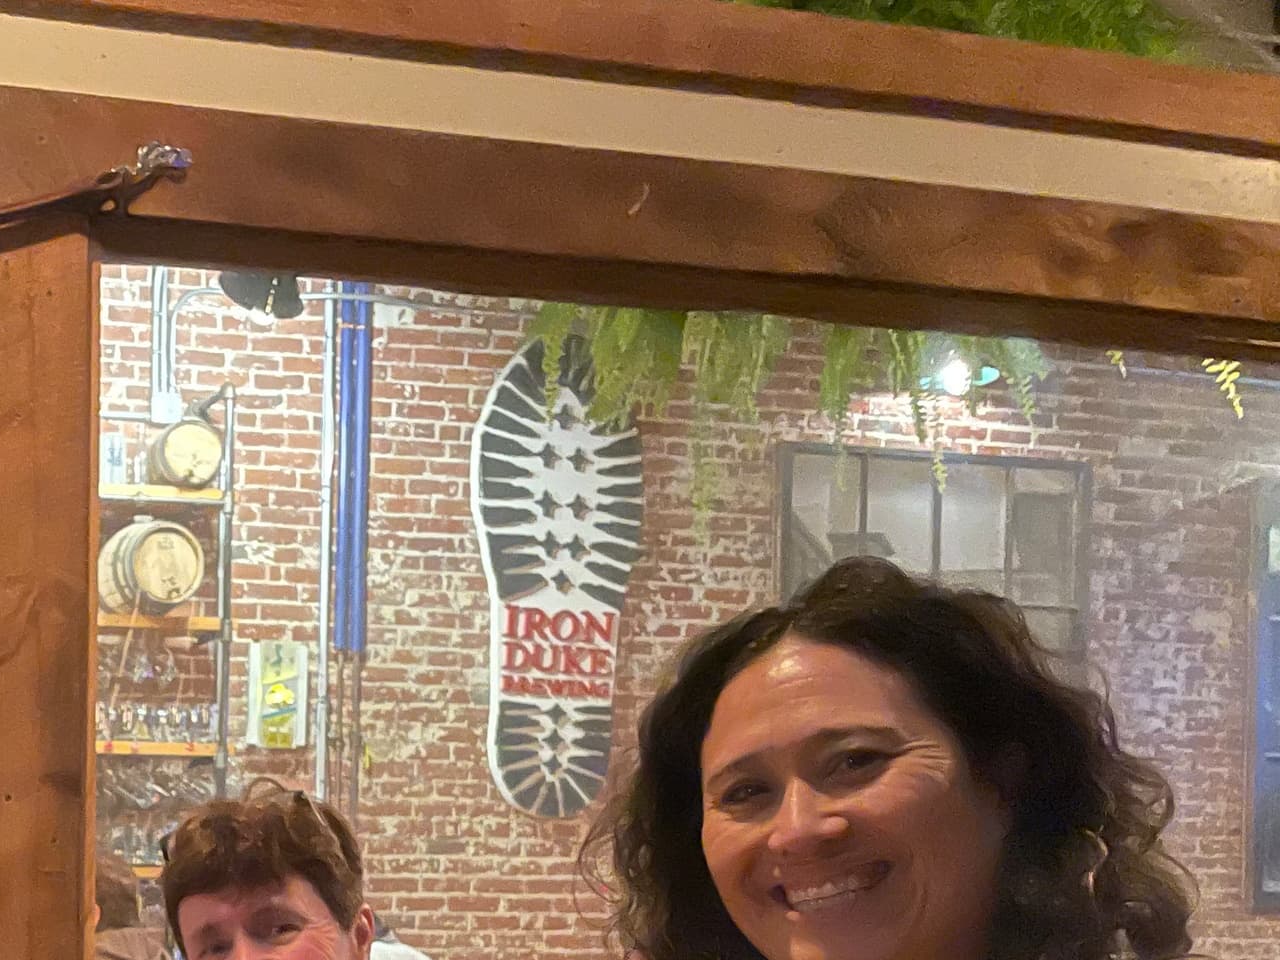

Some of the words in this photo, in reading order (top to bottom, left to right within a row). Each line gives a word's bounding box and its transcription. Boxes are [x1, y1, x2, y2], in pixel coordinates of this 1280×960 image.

[502, 603, 616, 642] IRON
[502, 641, 613, 676] DUKE
[501, 674, 611, 699] BREWING
